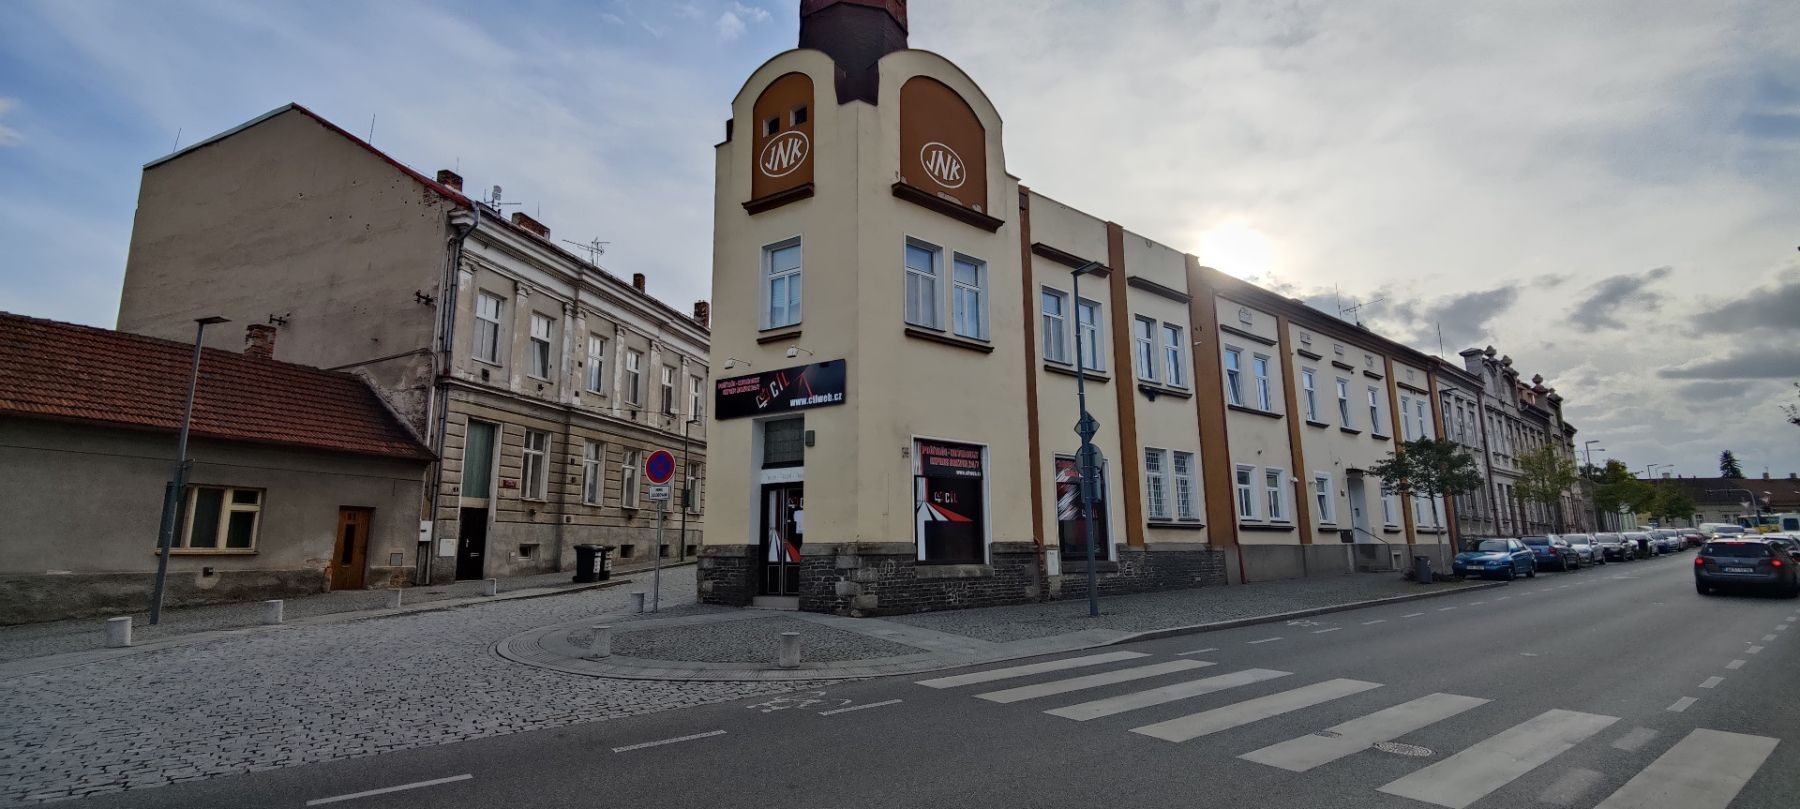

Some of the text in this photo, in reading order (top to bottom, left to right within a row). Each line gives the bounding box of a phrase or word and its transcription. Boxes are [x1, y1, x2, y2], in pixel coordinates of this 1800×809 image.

[765, 138, 803, 171] JNK
[926, 150, 961, 181] JNK
[790, 393, 842, 406] www.cilweb.cz
